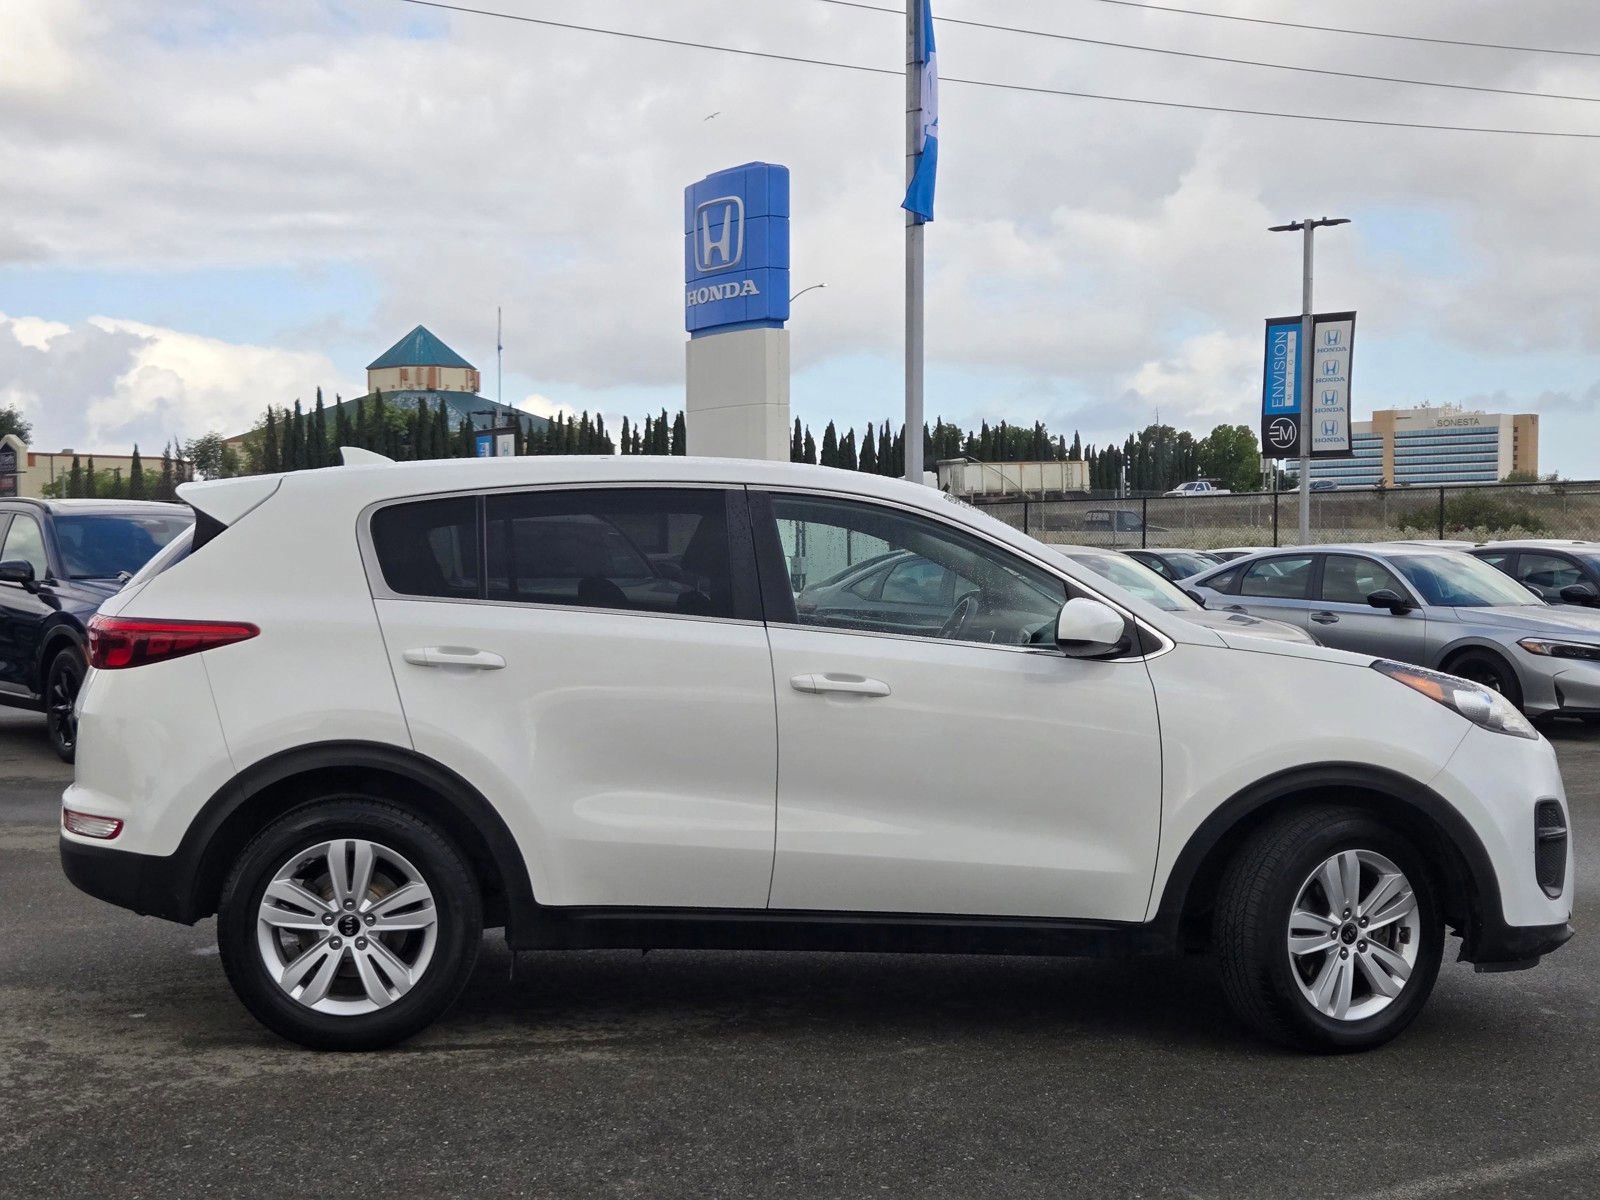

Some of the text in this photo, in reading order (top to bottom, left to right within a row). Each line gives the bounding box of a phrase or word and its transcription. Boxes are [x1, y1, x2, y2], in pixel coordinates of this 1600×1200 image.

[687, 279, 760, 307] HONDA
[1272, 331, 1287, 408] ENVISION
[1437, 417, 1480, 427] SONESTA
